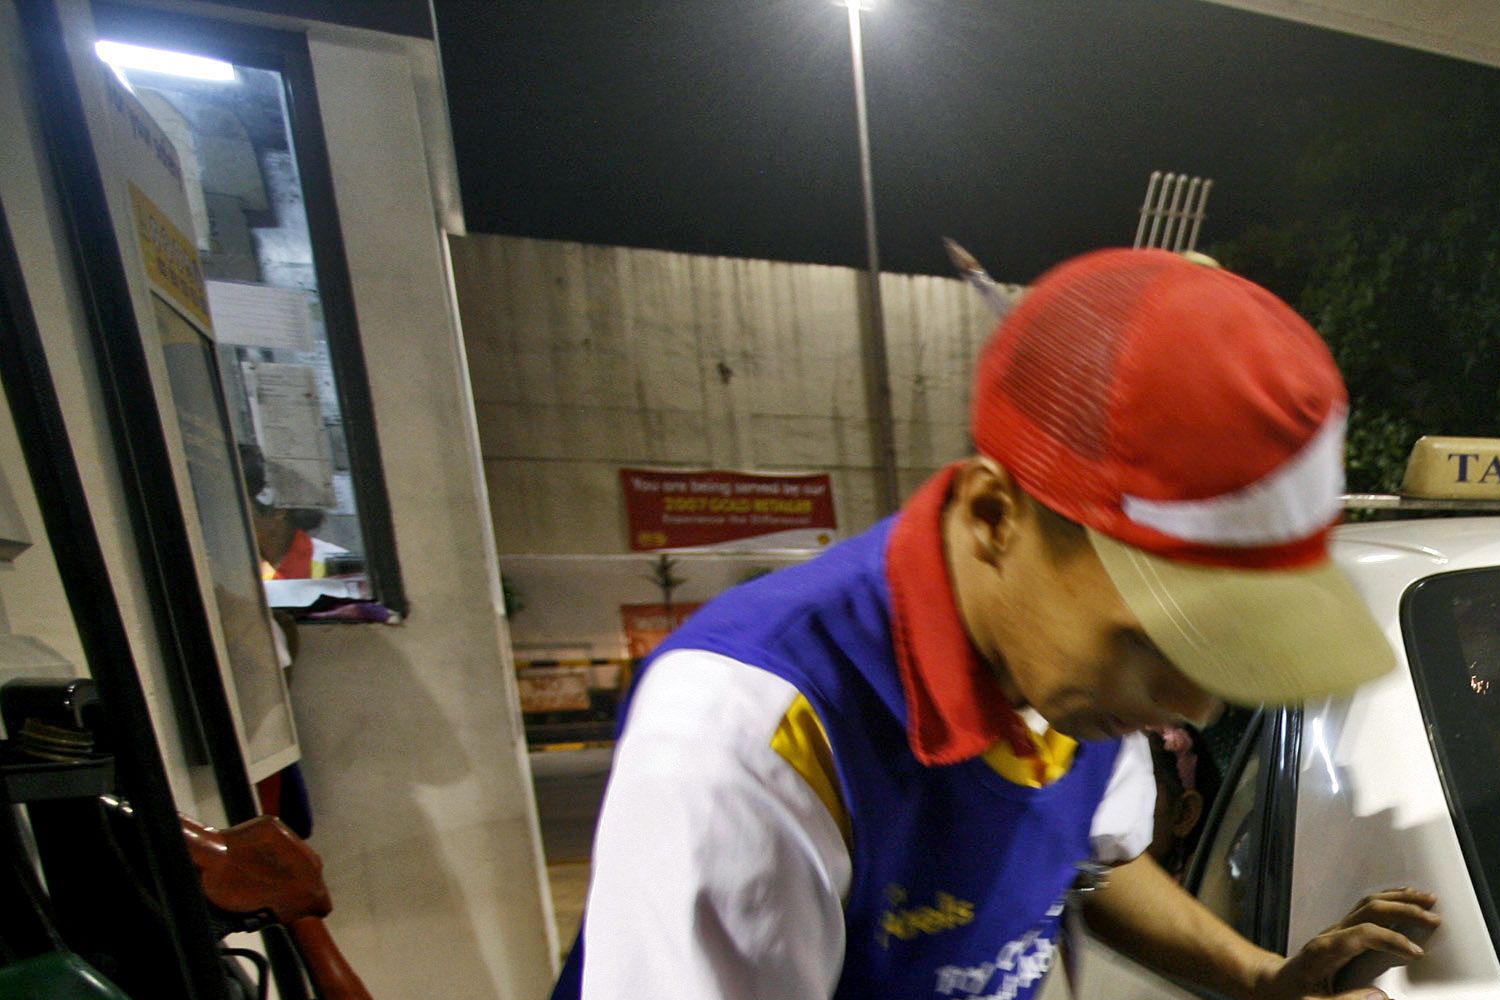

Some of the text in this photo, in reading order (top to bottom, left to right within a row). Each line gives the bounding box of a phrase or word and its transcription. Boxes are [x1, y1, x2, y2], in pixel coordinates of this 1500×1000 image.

[632, 477, 826, 497] You are being served by our
[664, 497, 706, 513] 2007
[709, 498, 751, 513] GOLD
